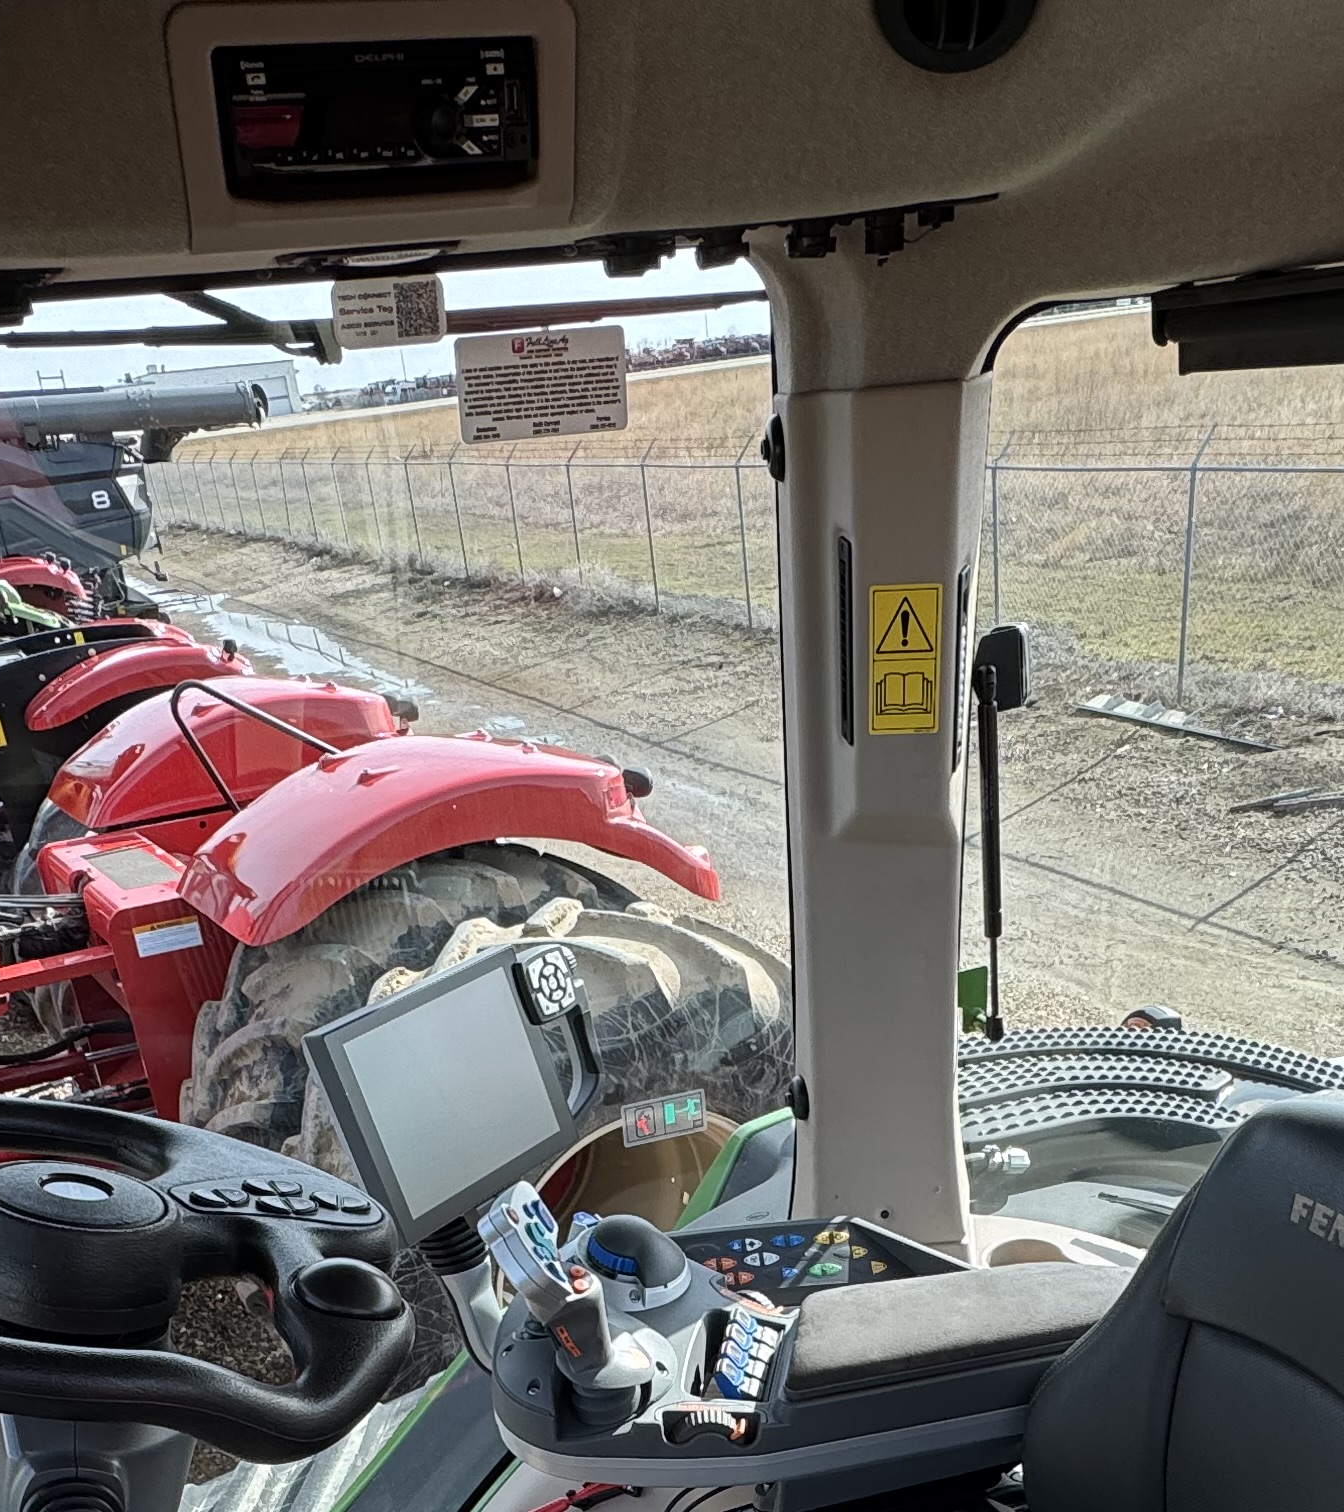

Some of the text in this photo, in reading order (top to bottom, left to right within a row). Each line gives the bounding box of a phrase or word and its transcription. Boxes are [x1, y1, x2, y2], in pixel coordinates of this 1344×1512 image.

[354, 53, 404, 63] DELPHI
[358, 291, 391, 300] CONNECT
[339, 305, 393, 316] Service Tag
[91, 490, 111, 509] 8
